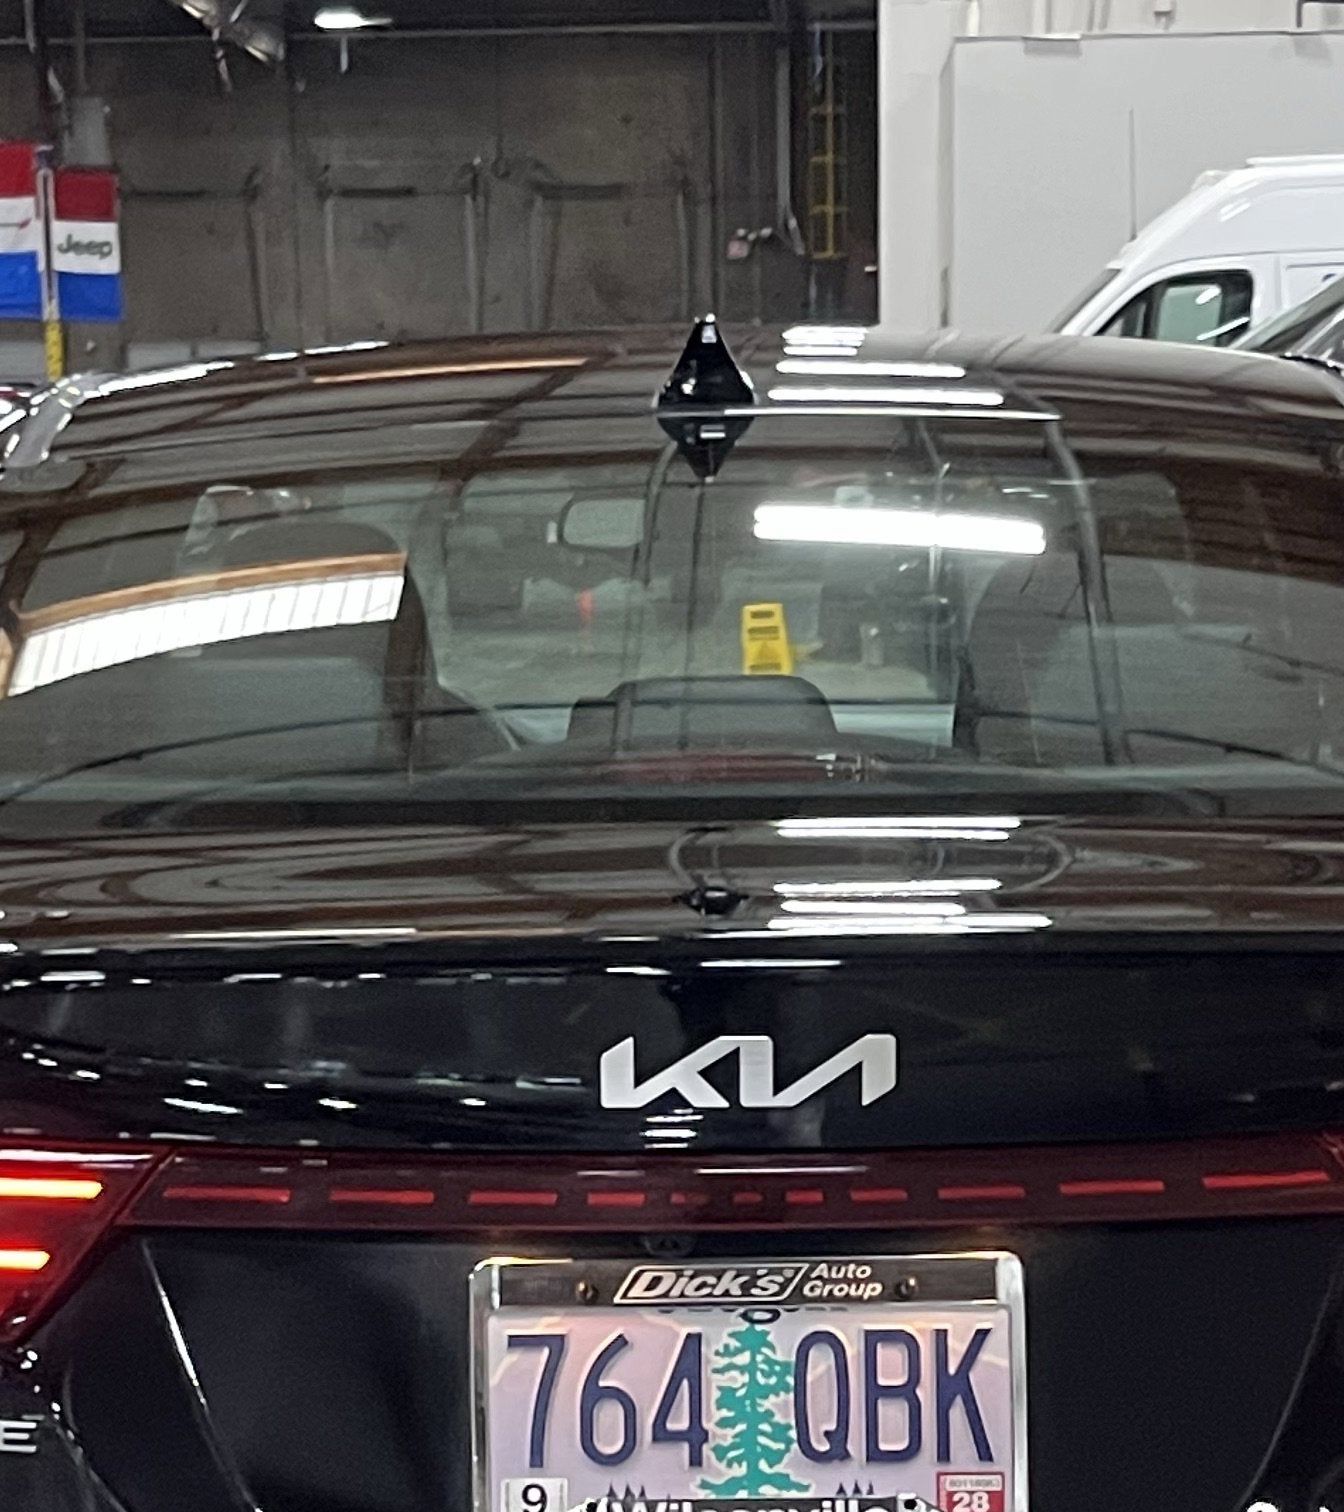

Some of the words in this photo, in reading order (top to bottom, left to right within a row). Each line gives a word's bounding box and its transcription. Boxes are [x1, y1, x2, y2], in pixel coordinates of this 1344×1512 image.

[57, 233, 113, 260] Jeep
[599, 1033, 897, 1109] KIA
[626, 1269, 785, 1299] Dick's
[809, 1262, 873, 1279] Auto
[802, 1279, 884, 1299] Group
[506, 1330, 710, 1469] 764
[792, 1328, 995, 1464] QBK
